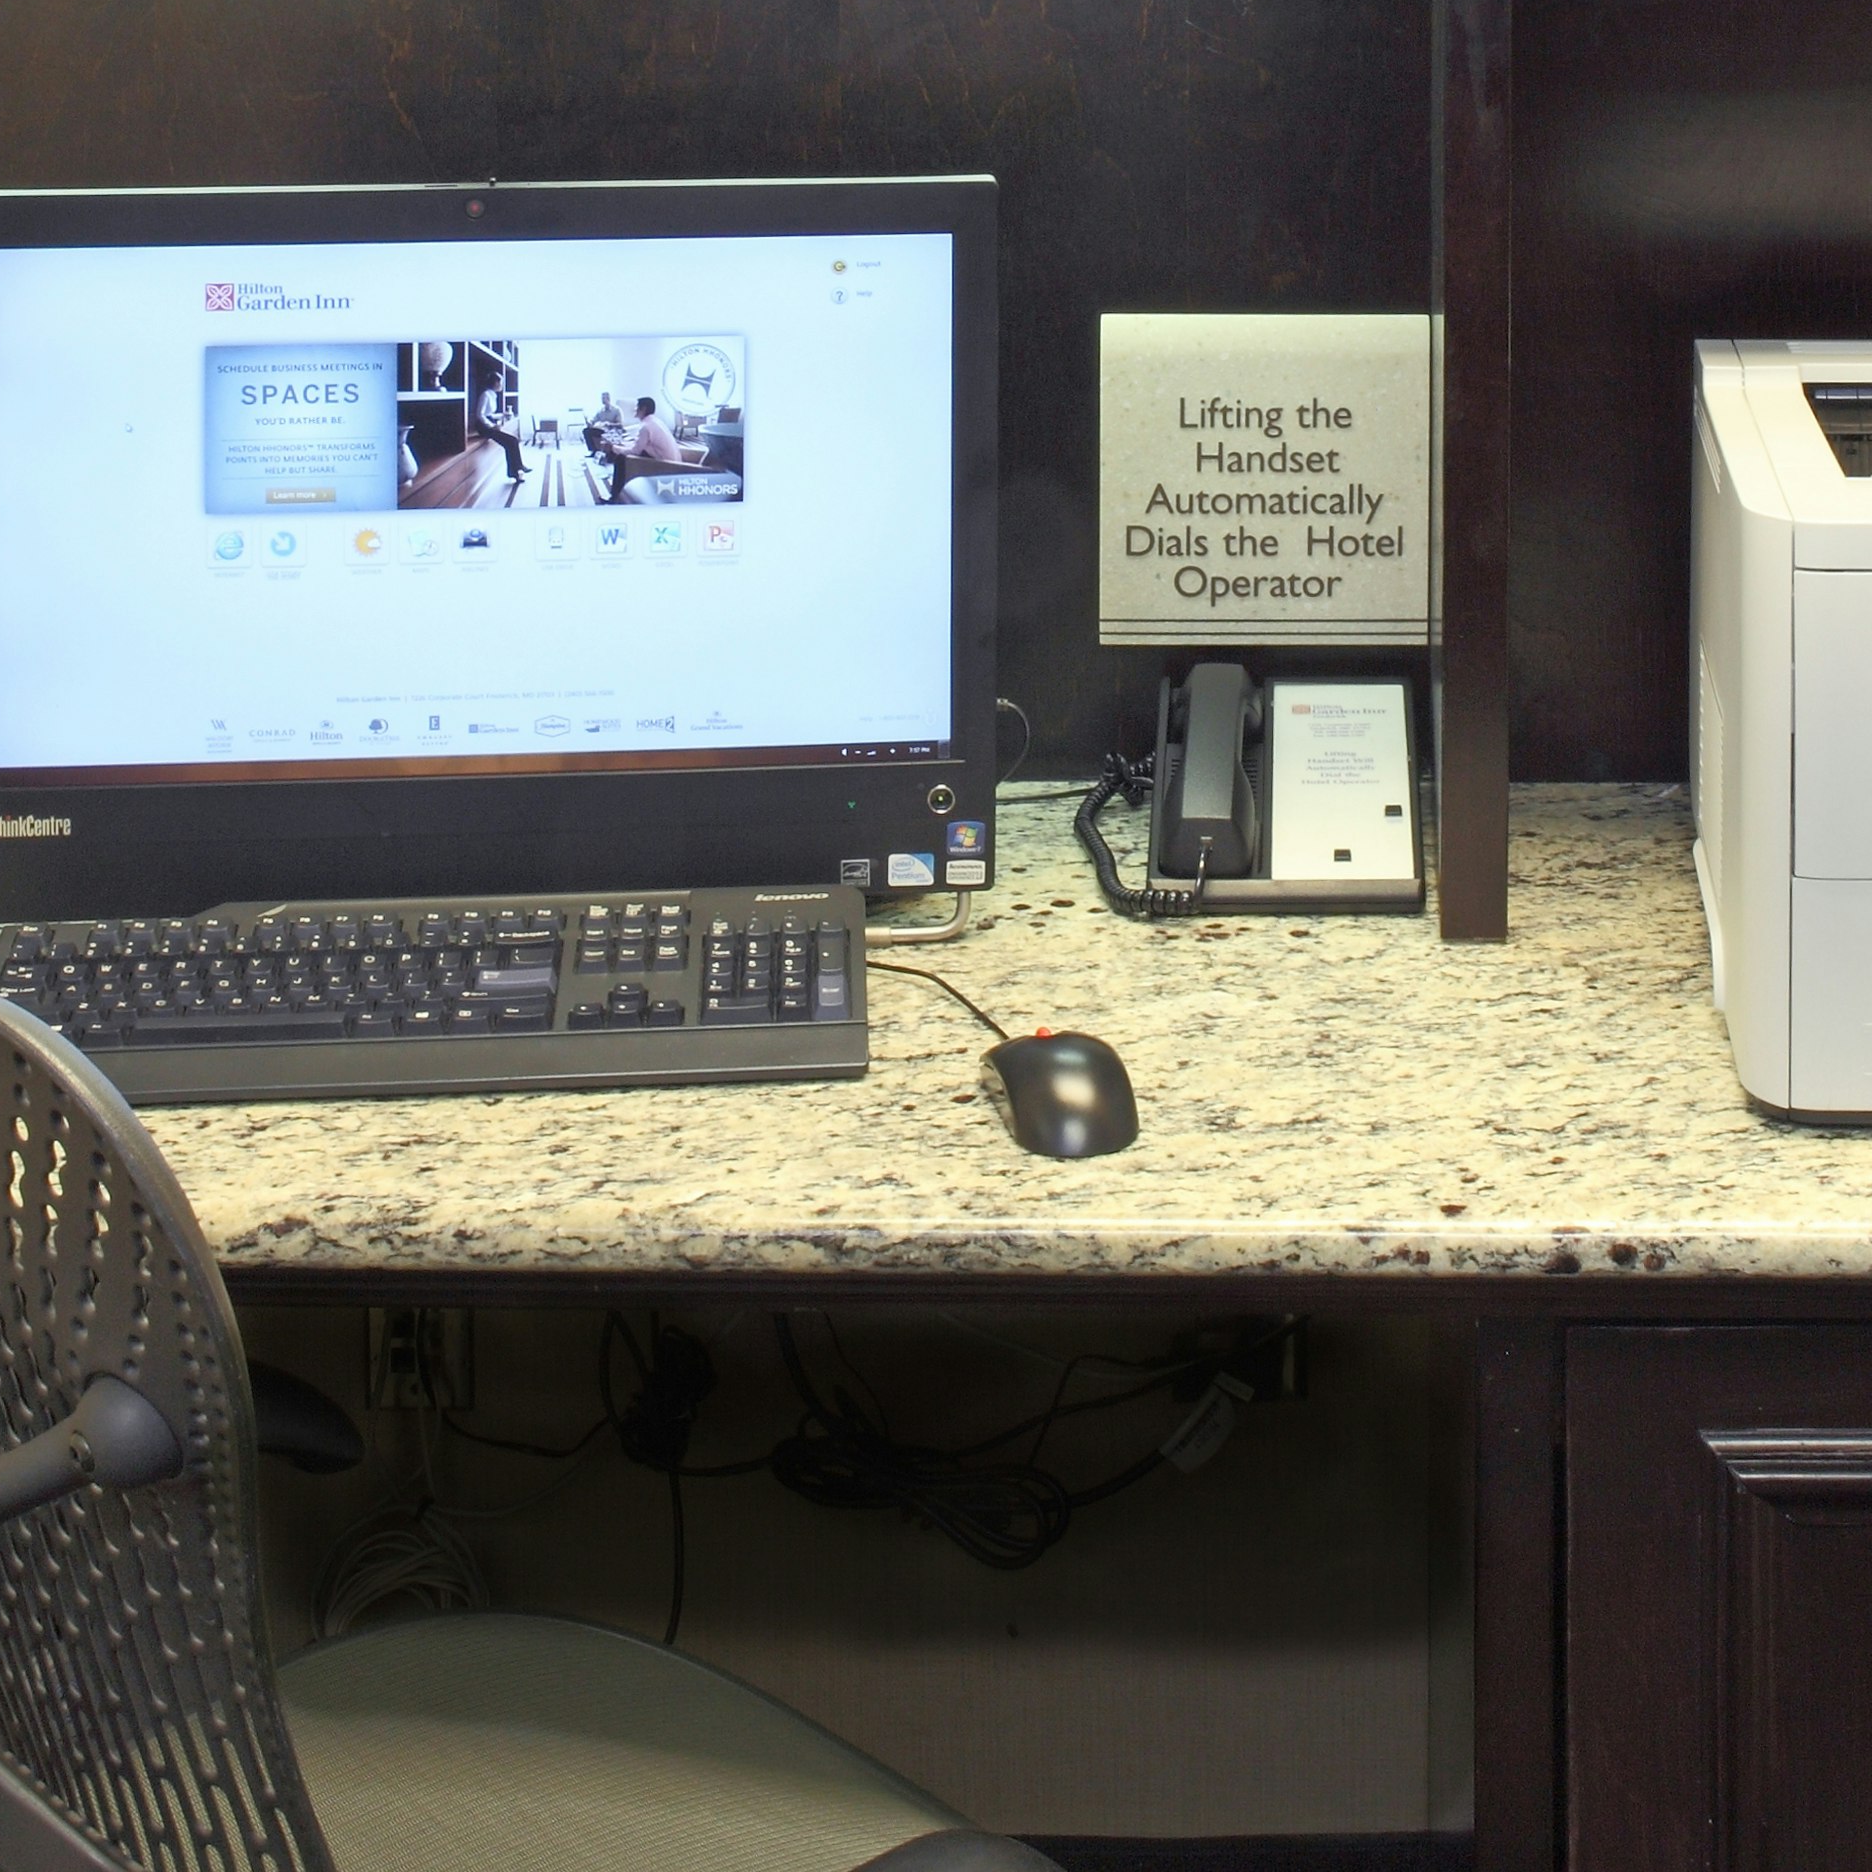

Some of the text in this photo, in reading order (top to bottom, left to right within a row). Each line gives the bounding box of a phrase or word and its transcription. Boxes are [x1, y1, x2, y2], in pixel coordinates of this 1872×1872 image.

[238, 283, 283, 294] Hilton
[237, 294, 350, 311] Garden Inn
[673, 348, 700, 367] HILTON
[217, 365, 268, 373] SCHEDULE
[272, 364, 318, 372] BUSINESS
[241, 384, 360, 405] SPACES
[255, 418, 286, 426] YOU'D
[289, 417, 328, 425] RATHER
[1179, 397, 1352, 437] Lifting the
[228, 445, 261, 453] HILTON
[317, 443, 376, 451] TRANSFORMS
[226, 456, 258, 464] POINTS
[284, 455, 330, 463] MEMORIES
[1196, 442, 1340, 473] Handset
[265, 467, 286, 475] HELP
[273, 491, 294, 499] Learn
[679, 484, 738, 495] HHONORS
[1145, 483, 1384, 524] Automatically
[1126, 526, 1404, 557] Dials the Hotel
[1174, 566, 1342, 607] Operator
[249, 729, 296, 738] CONRAD
[310, 730, 343, 741] Hilton
[754, 893, 829, 901] lenovo
